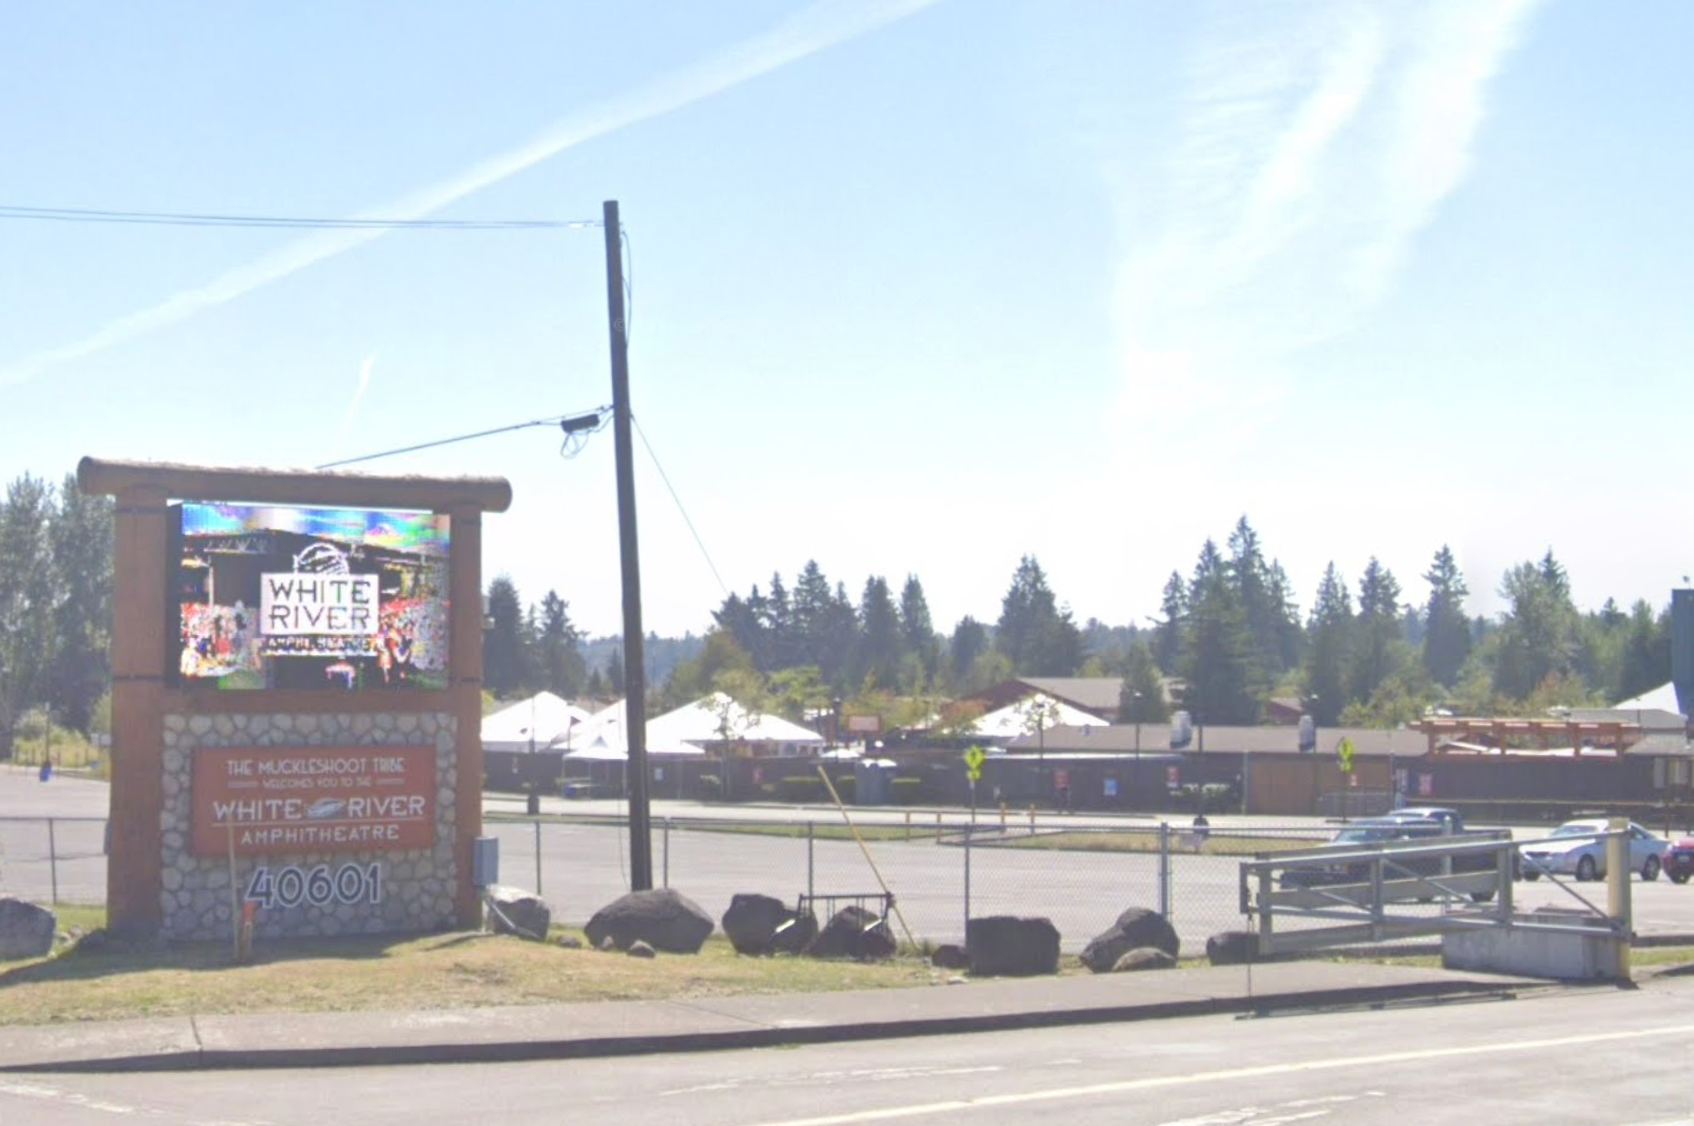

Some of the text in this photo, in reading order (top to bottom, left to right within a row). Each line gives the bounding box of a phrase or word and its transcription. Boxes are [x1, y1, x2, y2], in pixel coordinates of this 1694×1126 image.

[269, 579, 371, 604] WHITE
[269, 605, 371, 630] RIVER
[227, 759, 253, 775] THE
[258, 757, 367, 775] MUCKLESHOOT
[317, 776, 339, 788] YOU
[340, 776, 353, 787] TO
[212, 795, 426, 821] WHITE RIVER
[240, 824, 400, 845] AMPHITHEATRE
[245, 862, 381, 909] 40601
